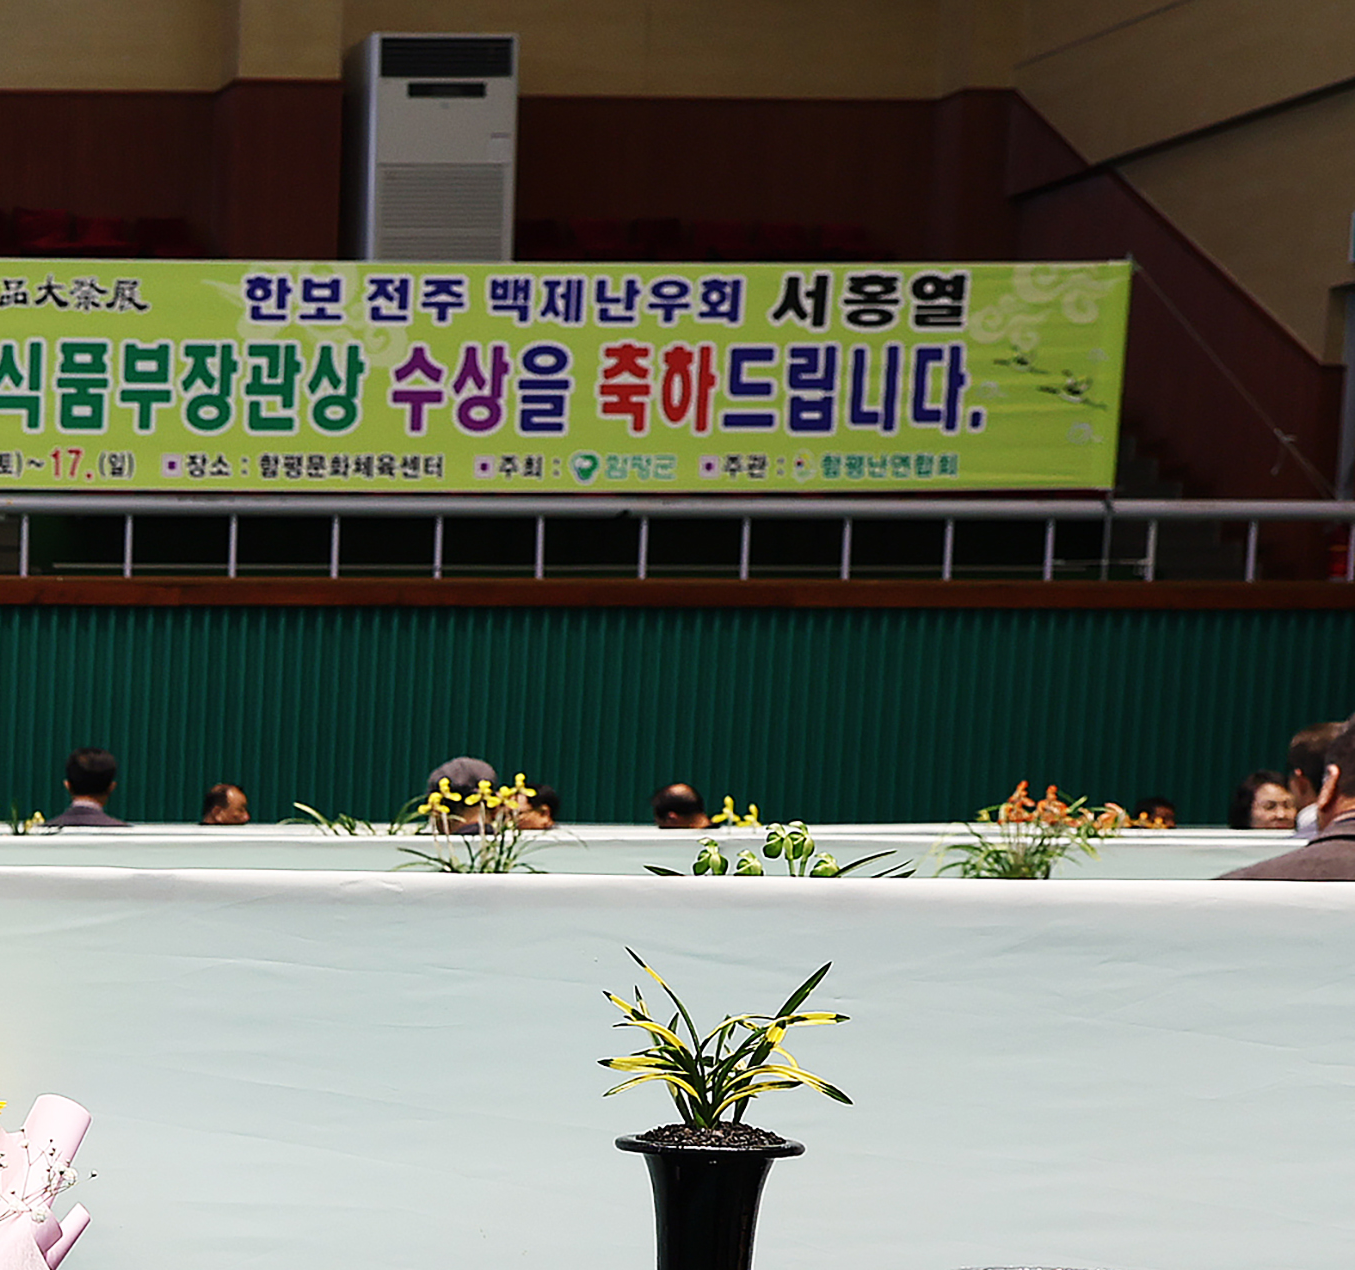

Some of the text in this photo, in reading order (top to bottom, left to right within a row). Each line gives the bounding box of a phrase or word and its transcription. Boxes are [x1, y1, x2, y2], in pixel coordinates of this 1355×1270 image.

[245, 273, 969, 327] 한보 전주 백제난우회 서홍열
[391, 344, 572, 432] 수상을
[598, 344, 986, 433] 축하드립니다.
[187, 453, 232, 478] 장소
